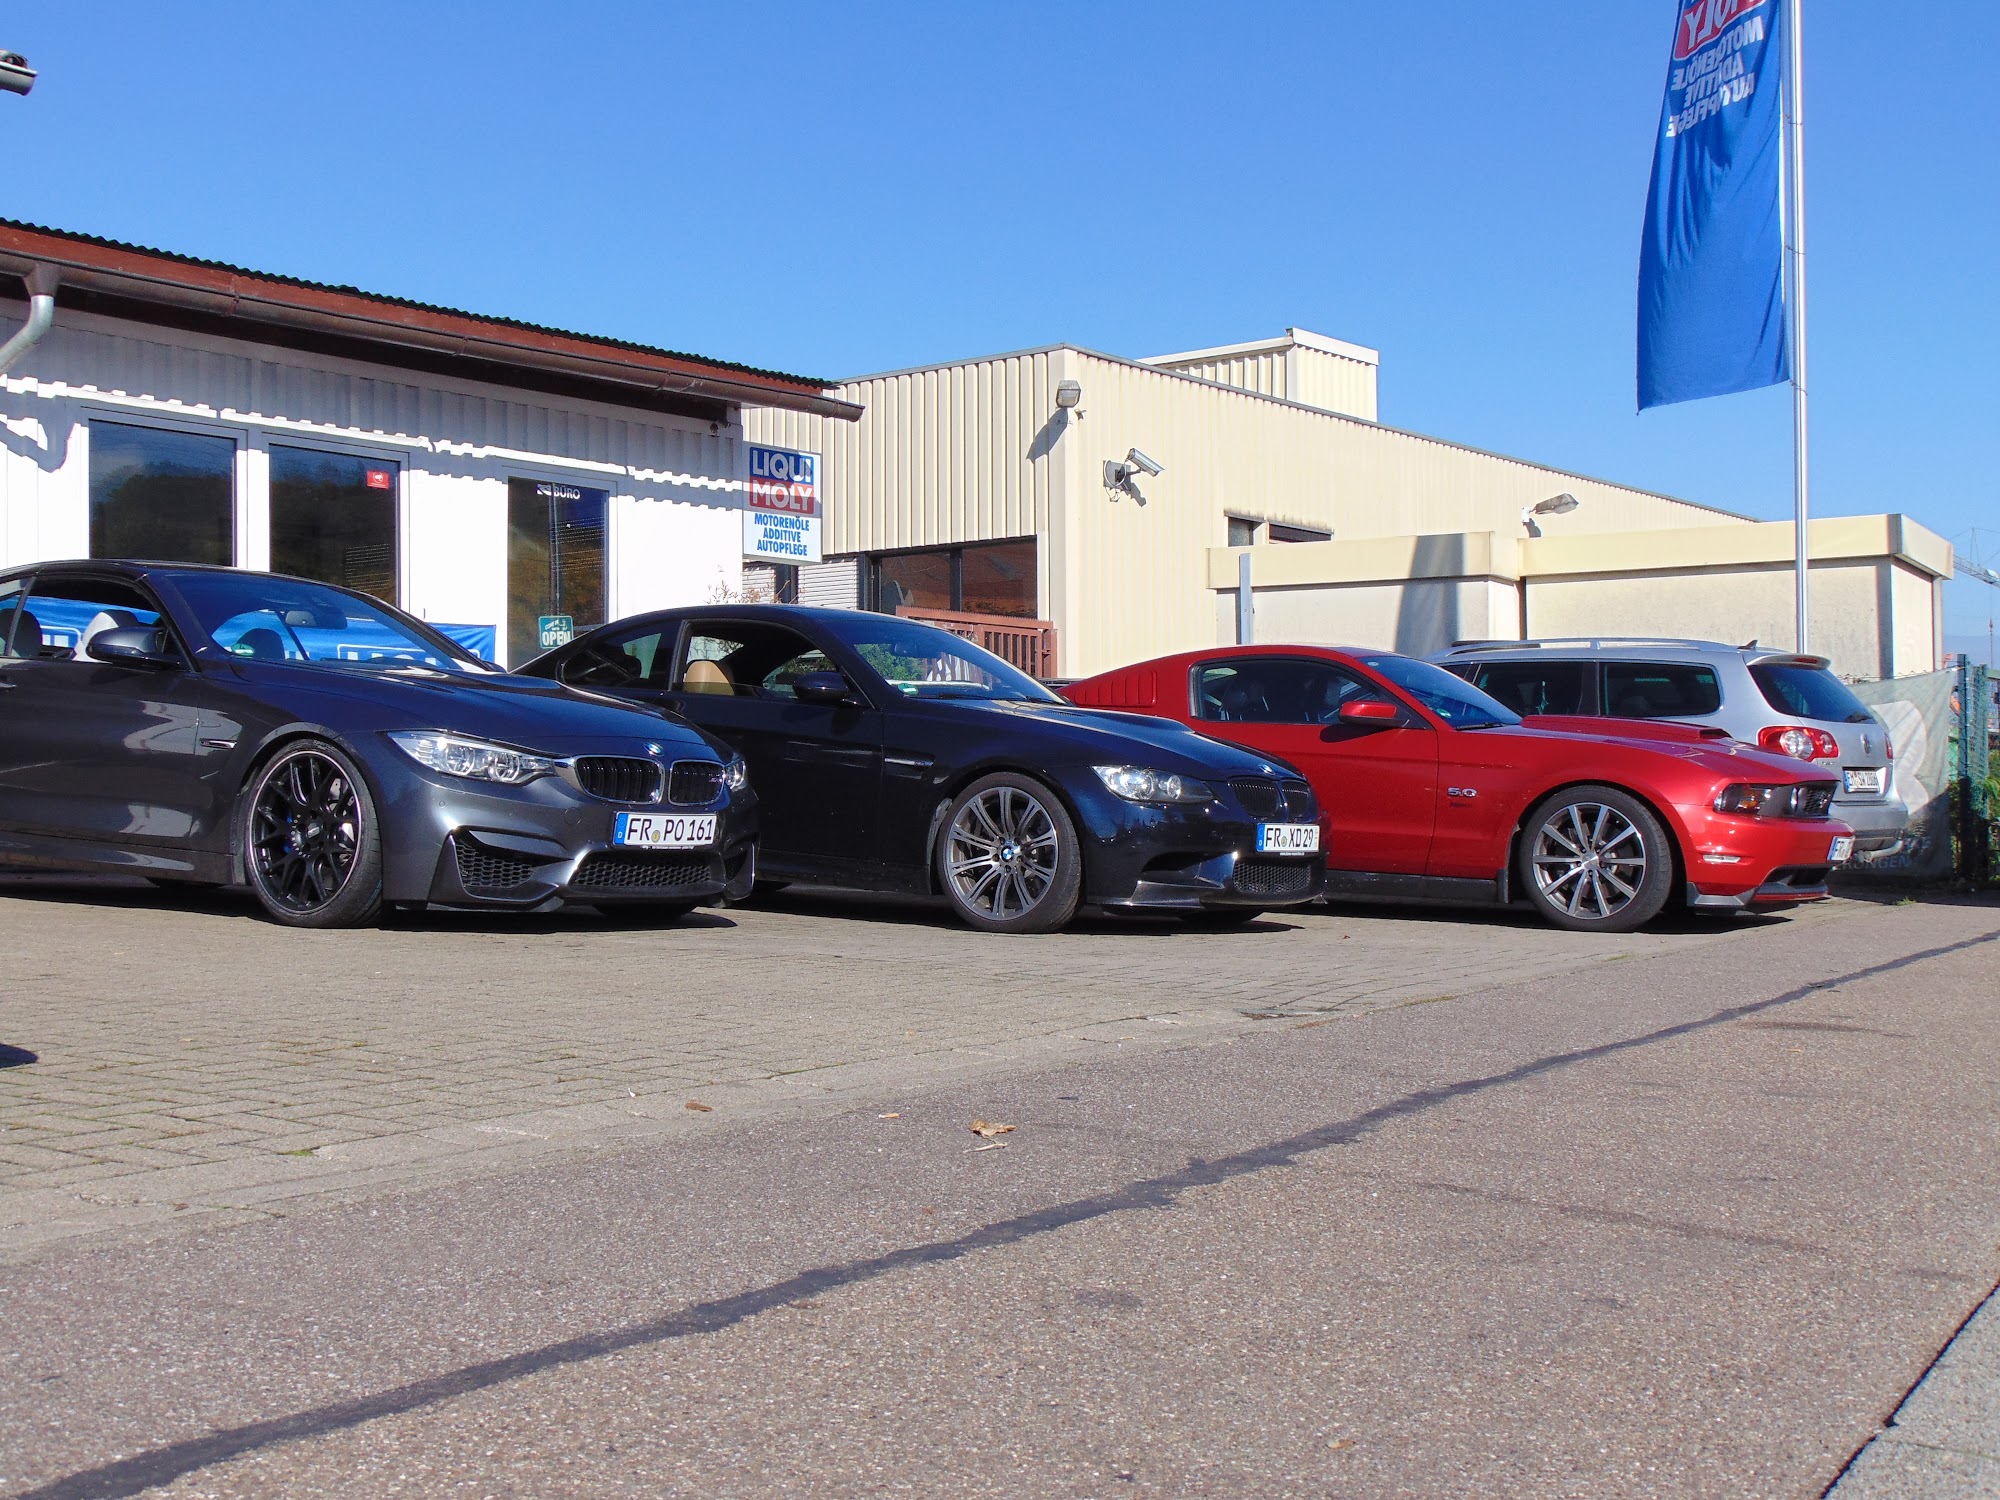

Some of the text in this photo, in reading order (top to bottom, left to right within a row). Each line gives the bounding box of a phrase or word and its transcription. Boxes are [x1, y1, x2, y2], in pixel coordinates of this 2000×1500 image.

[752, 449, 812, 482] LIQUI
[553, 484, 581, 500] BÜRO
[752, 480, 813, 511] MOLY
[754, 512, 810, 532] MOTORENÖLE
[762, 527, 802, 543] ADDITIVE
[756, 539, 808, 557] AUTOPFLEGE
[541, 630, 571, 646] OPEN
[627, 818, 652, 841] FR
[1265, 827, 1281, 848] FR
